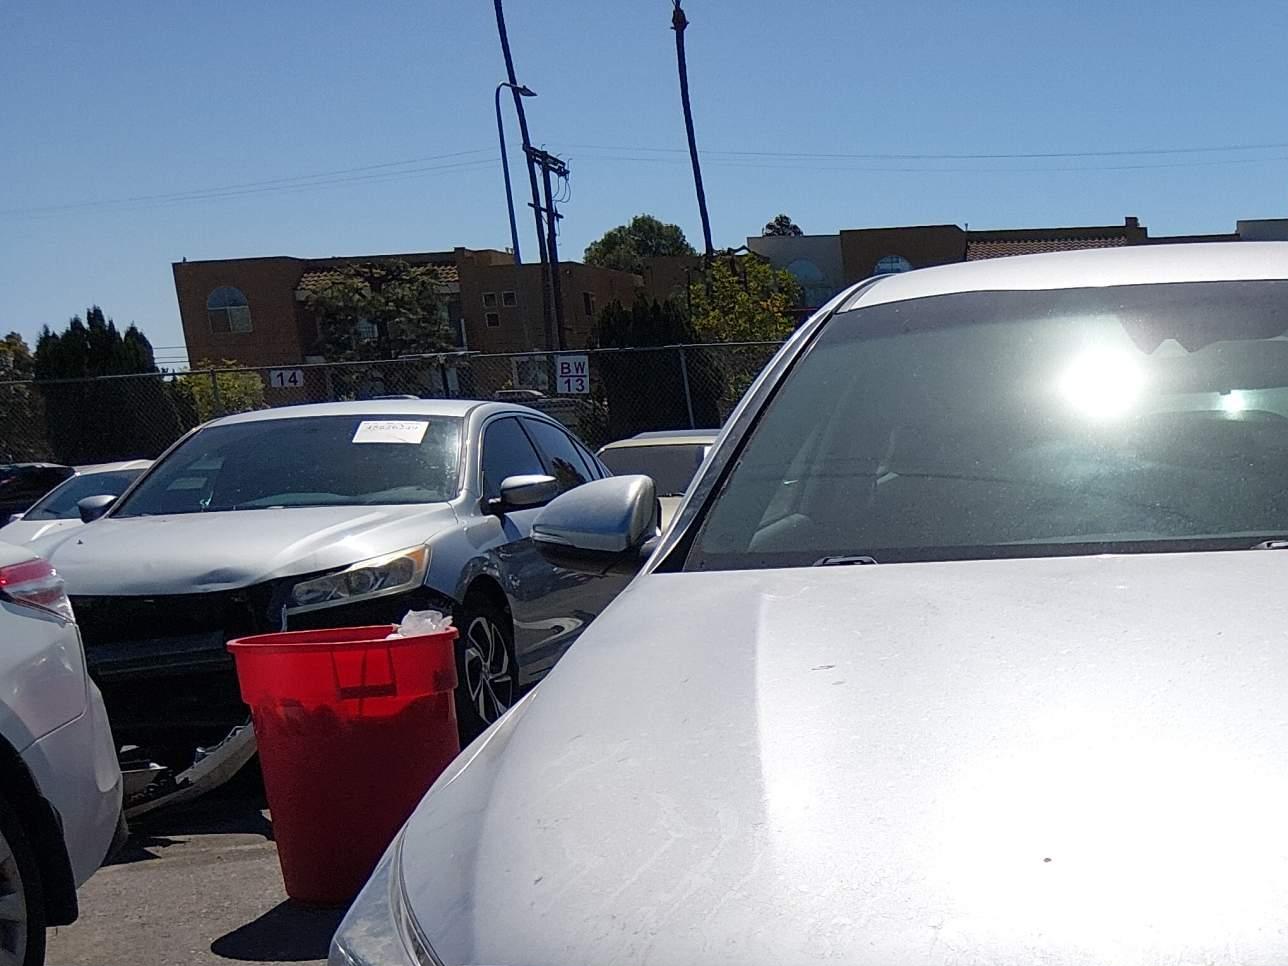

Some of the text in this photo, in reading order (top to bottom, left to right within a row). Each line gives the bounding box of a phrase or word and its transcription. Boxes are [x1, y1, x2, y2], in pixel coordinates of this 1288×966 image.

[560, 361, 586, 375] BW
[276, 371, 299, 387] 14
[564, 378, 585, 393] 13
